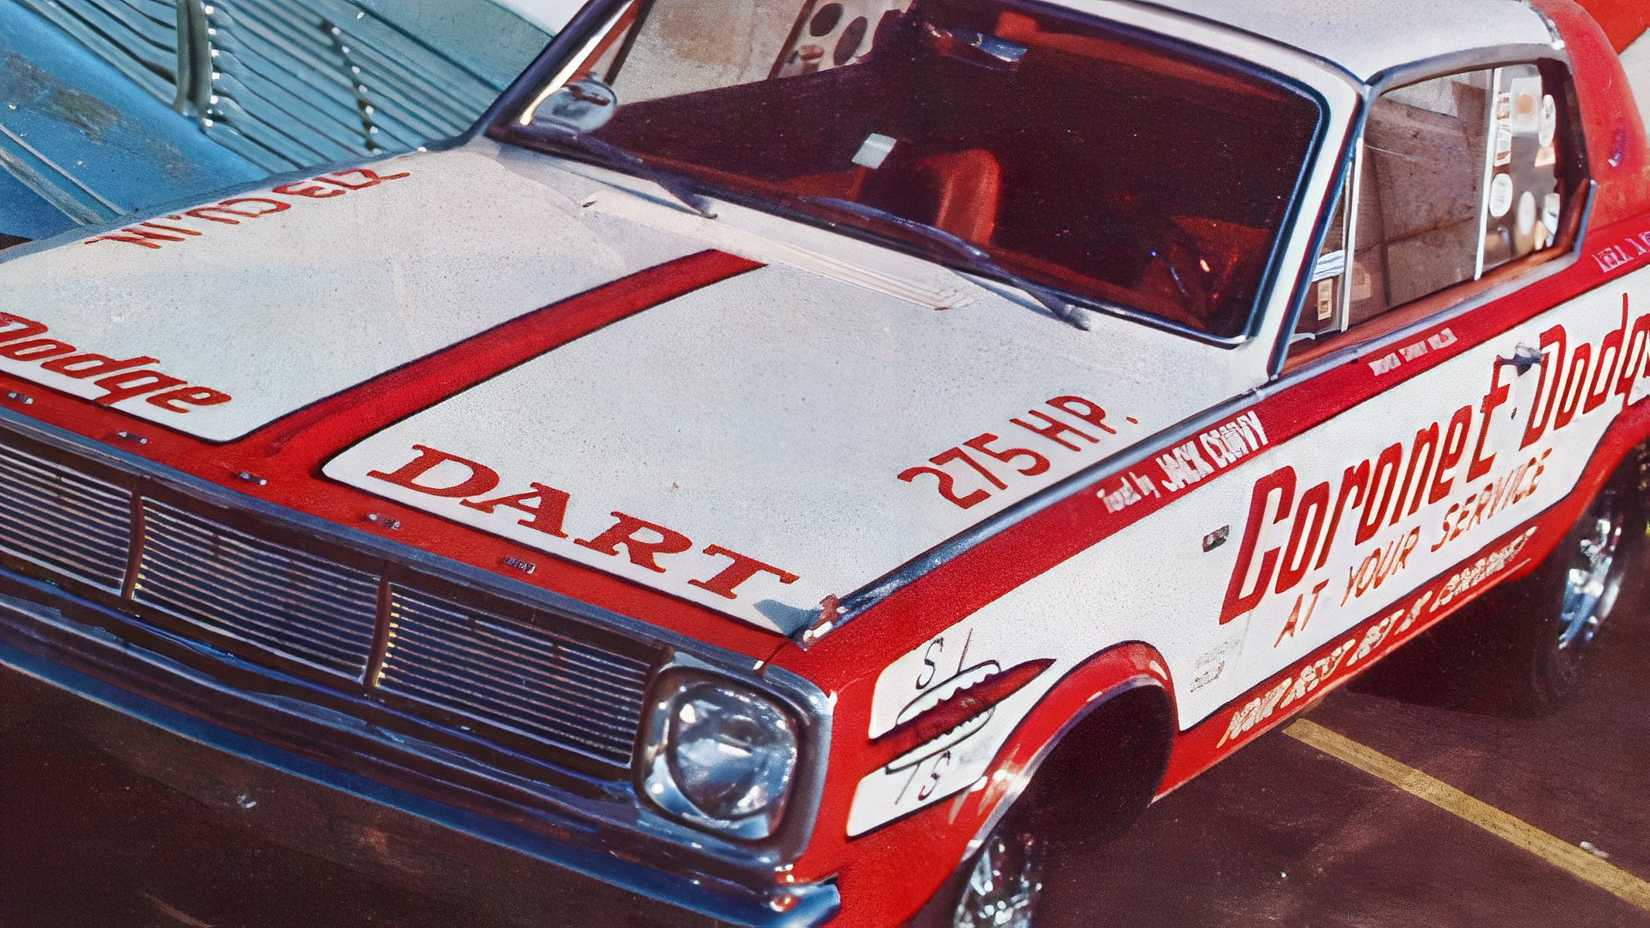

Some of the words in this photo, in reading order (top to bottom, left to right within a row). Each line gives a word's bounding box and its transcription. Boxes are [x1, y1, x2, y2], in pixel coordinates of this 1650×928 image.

[366, 443, 801, 600] DART
[897, 432, 1051, 510] 275
[1218, 354, 1510, 625] Coronet
[1519, 292, 1650, 451] Dodg
[1274, 578, 1329, 648] AT
[1339, 525, 1420, 608] YOUR
[1430, 447, 1552, 553] SERVICE
